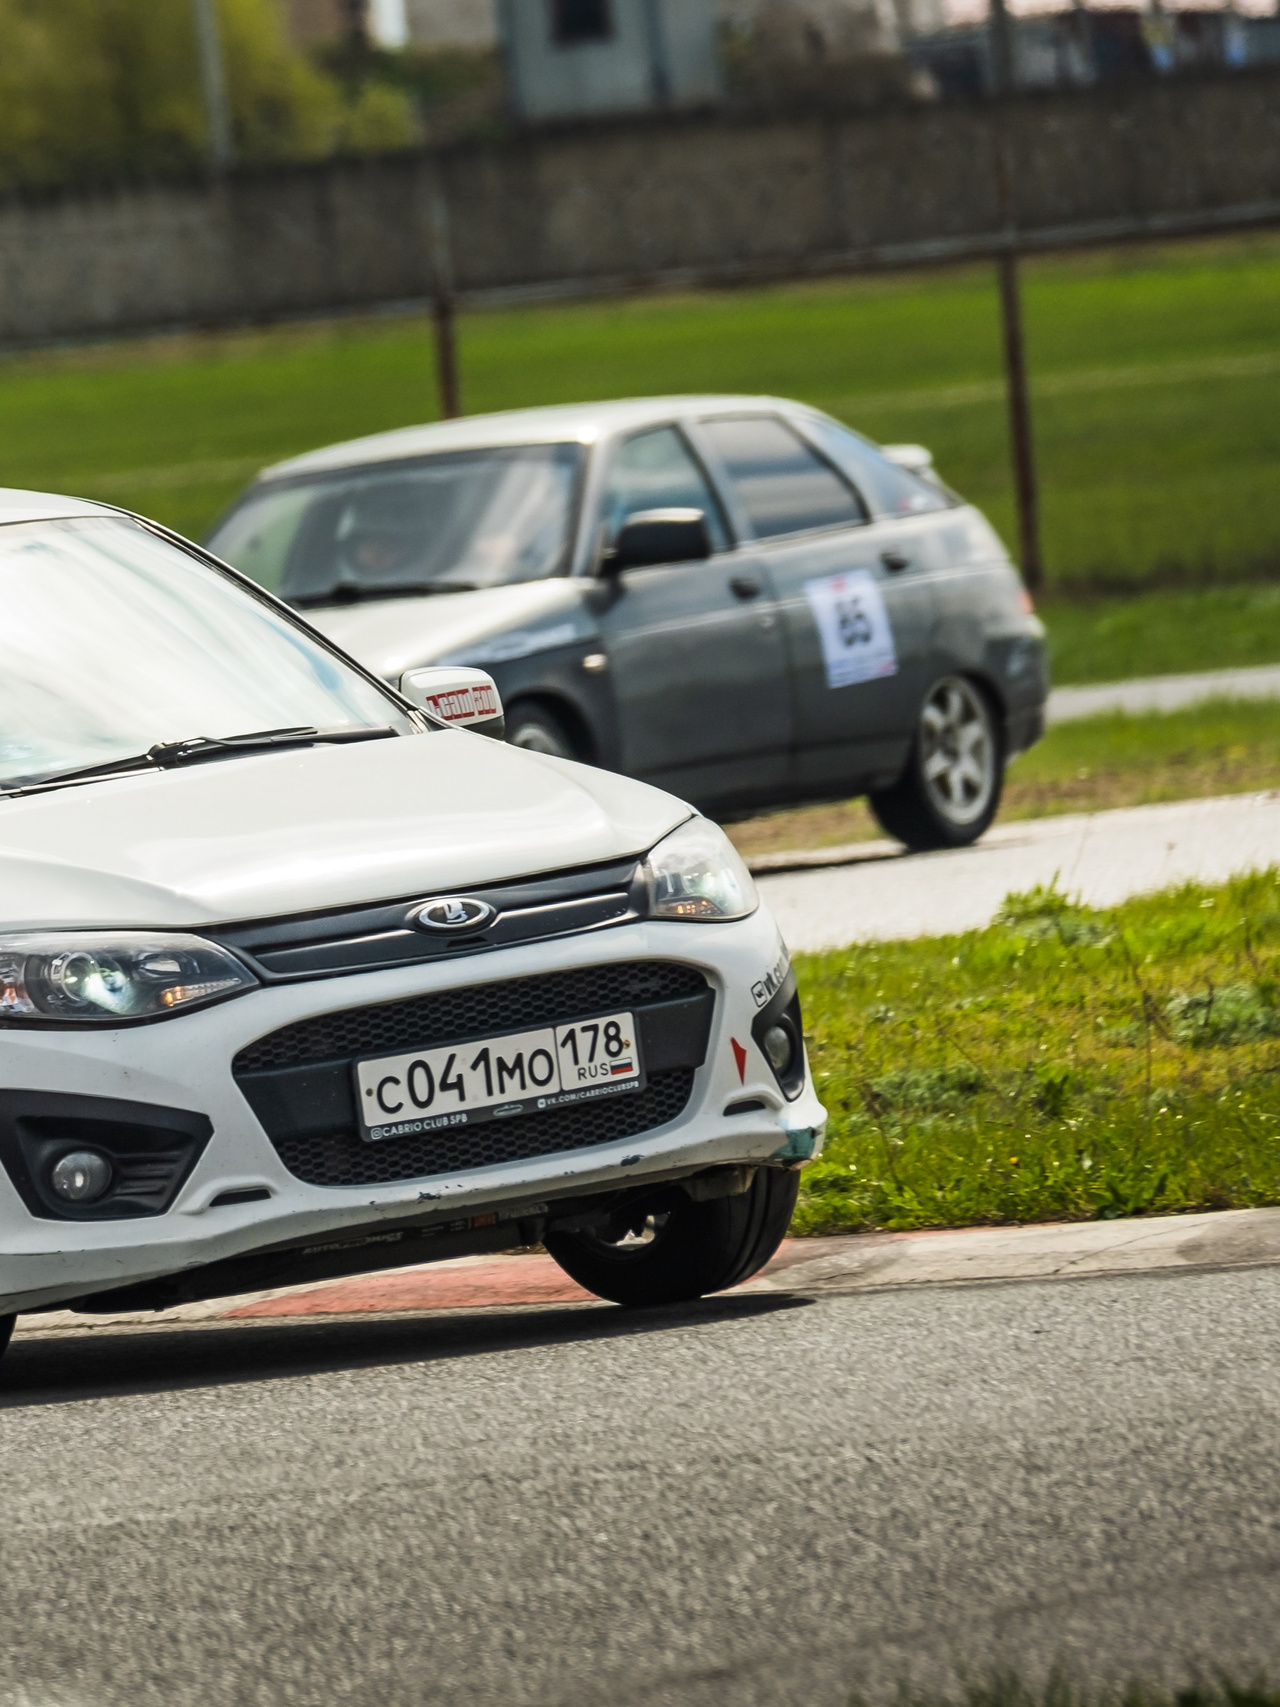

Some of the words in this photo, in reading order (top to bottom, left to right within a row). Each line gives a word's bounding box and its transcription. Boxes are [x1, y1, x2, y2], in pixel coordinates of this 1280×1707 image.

[560, 1020, 624, 1066] 178
[376, 1047, 554, 1114] C041MO
[578, 1063, 609, 1080] RUS
[382, 1122, 421, 1137] CABRIO
[423, 1116, 449, 1130] CLUB
[450, 1113, 468, 1125] SPB
